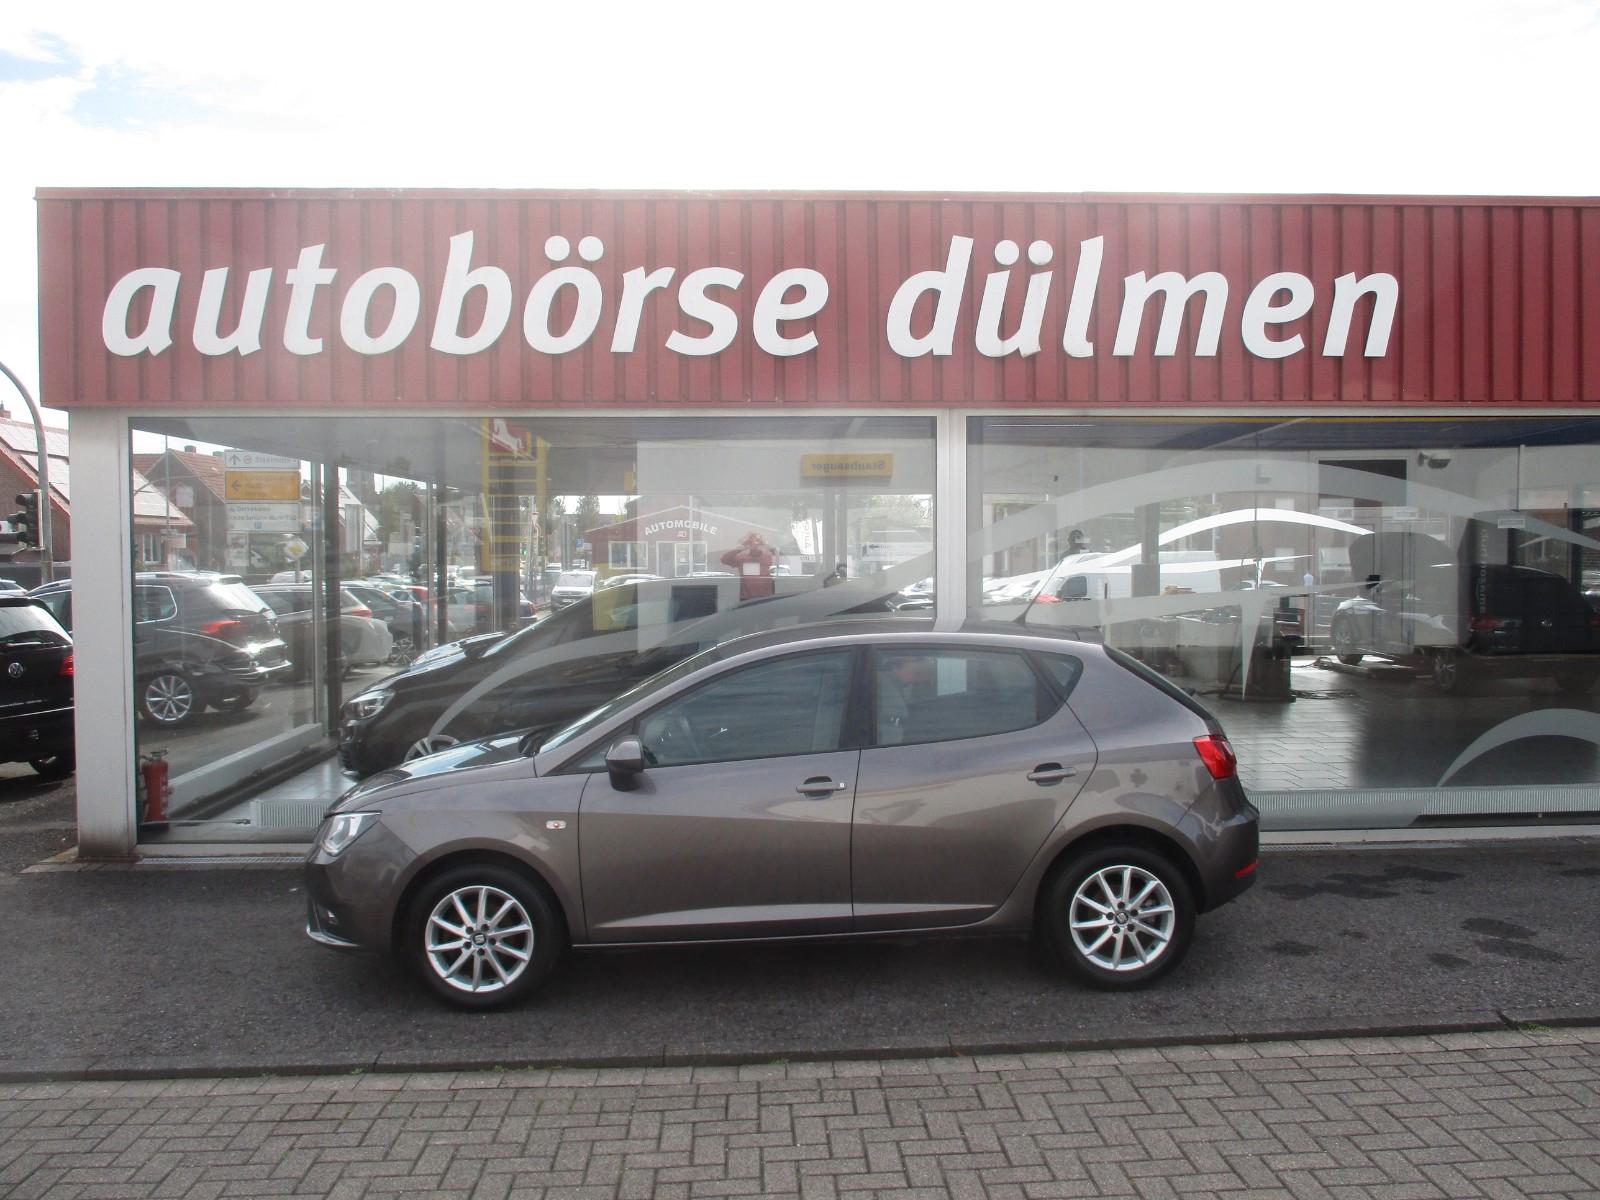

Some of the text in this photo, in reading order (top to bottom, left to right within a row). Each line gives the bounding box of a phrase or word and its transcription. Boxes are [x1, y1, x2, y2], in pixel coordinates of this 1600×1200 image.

[103, 231, 1399, 358] autobörse dülmen
[644, 519, 718, 536] AUTOMOBILE
